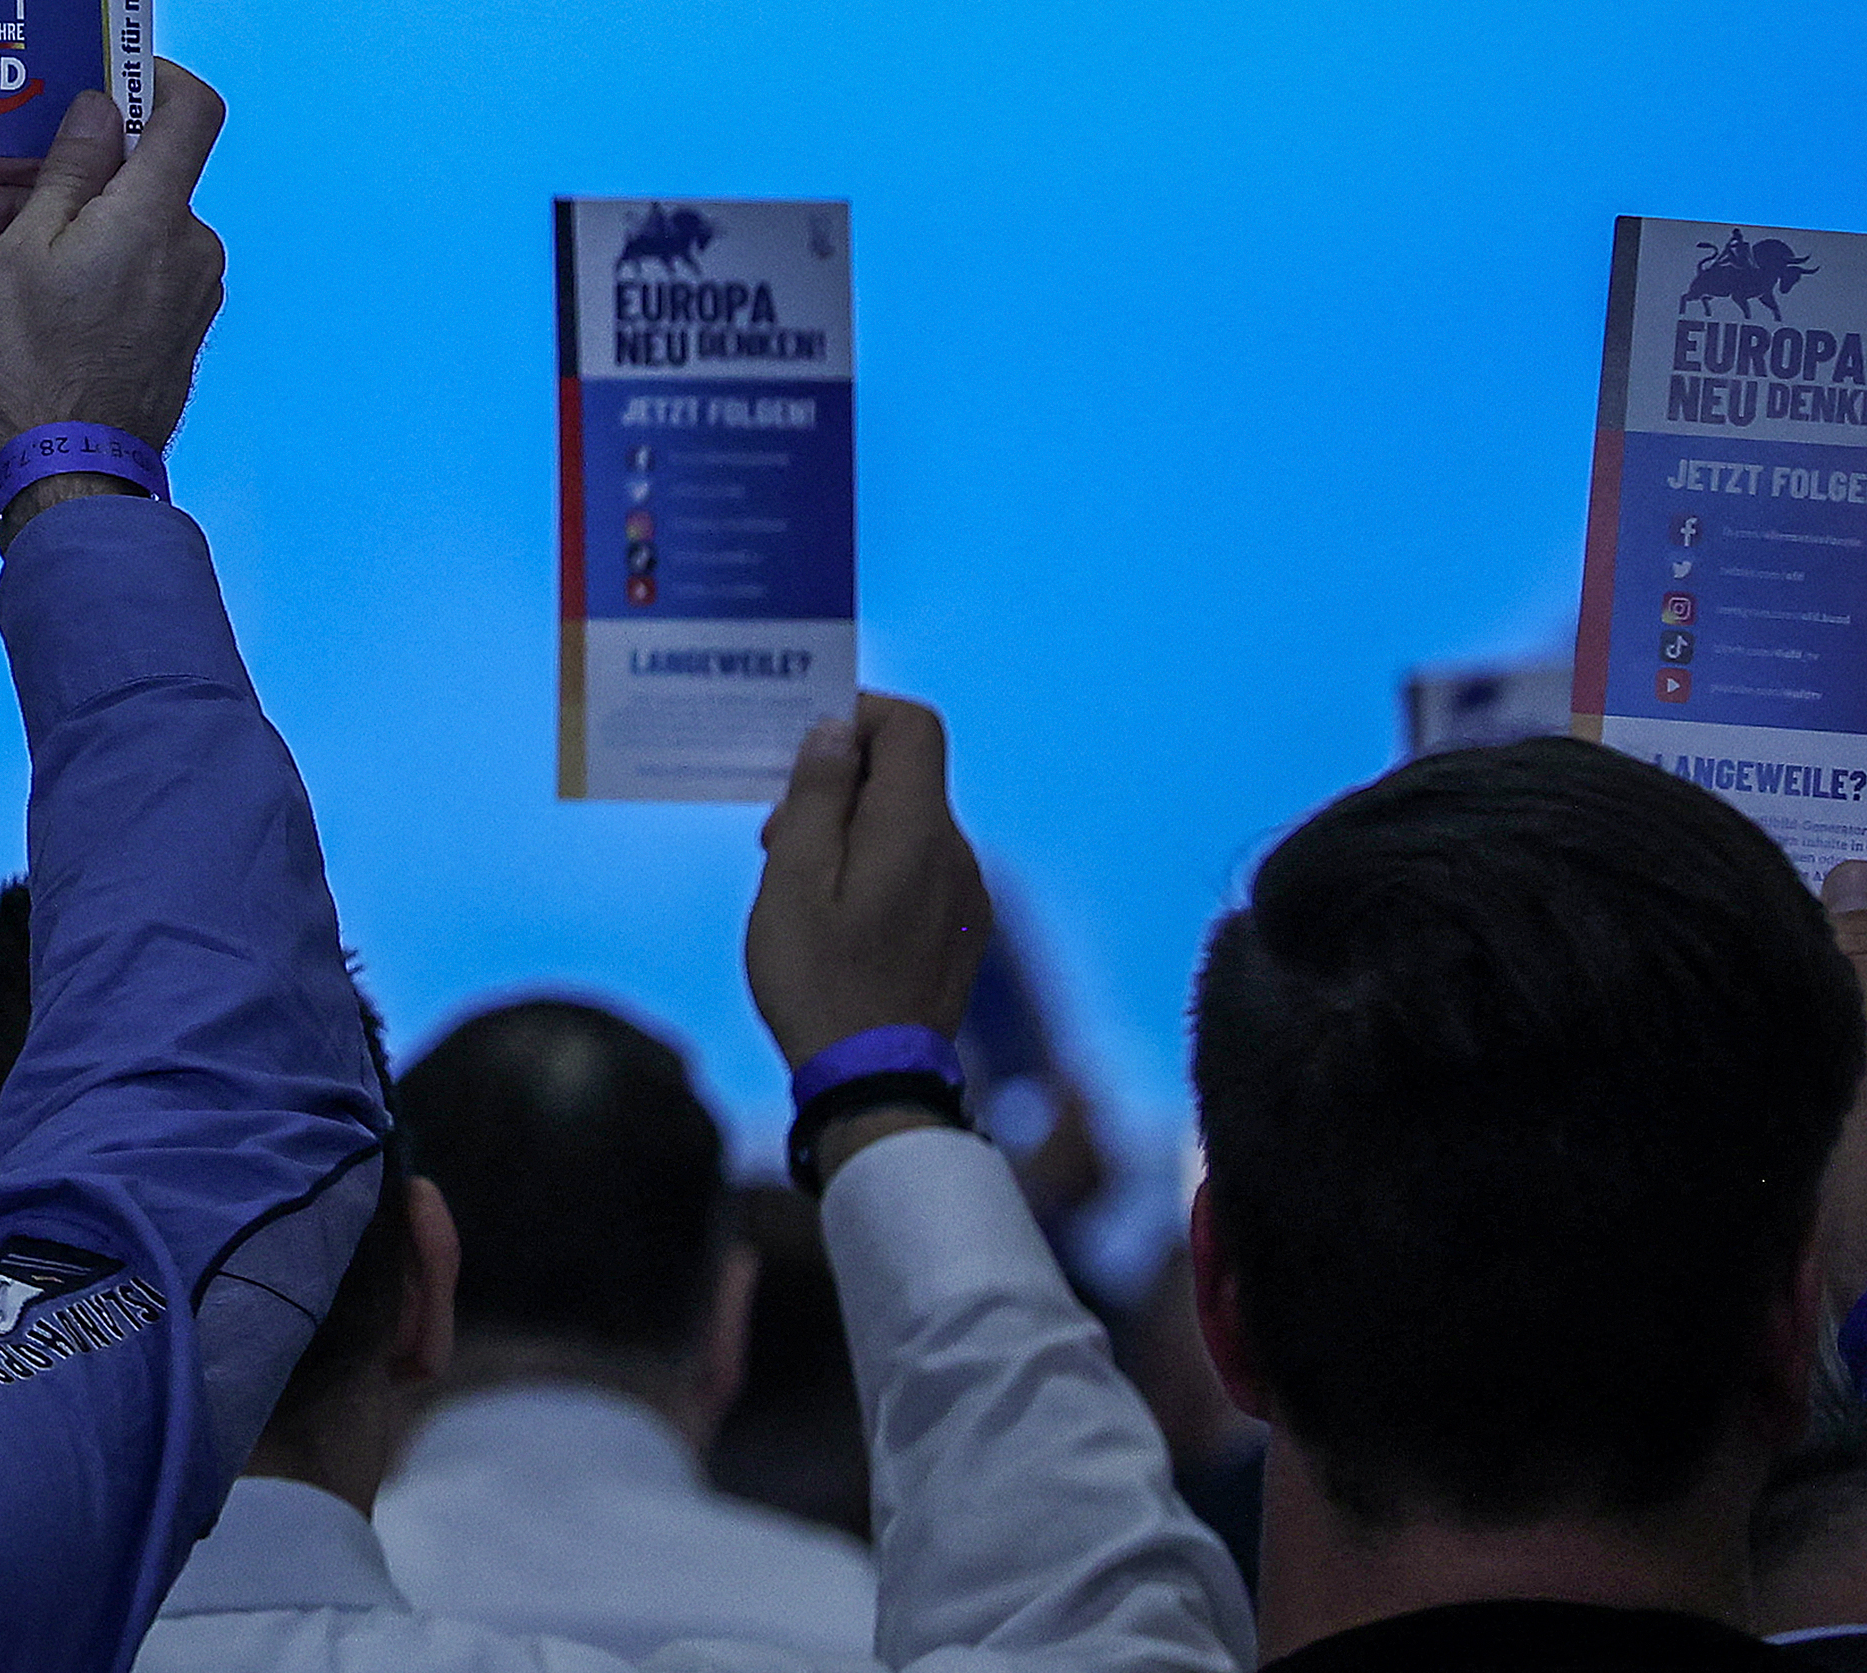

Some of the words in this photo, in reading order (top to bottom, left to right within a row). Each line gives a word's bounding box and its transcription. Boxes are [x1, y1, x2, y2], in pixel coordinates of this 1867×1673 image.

[122, 18, 141, 56] für
[124, 61, 143, 135] Bereit
[616, 281, 776, 324] EUROPA
[615, 330, 687, 367] NEU
[1673, 319, 1865, 385] EUROPA
[1668, 375, 1758, 427] NEU
[1668, 459, 1764, 496] JETZT
